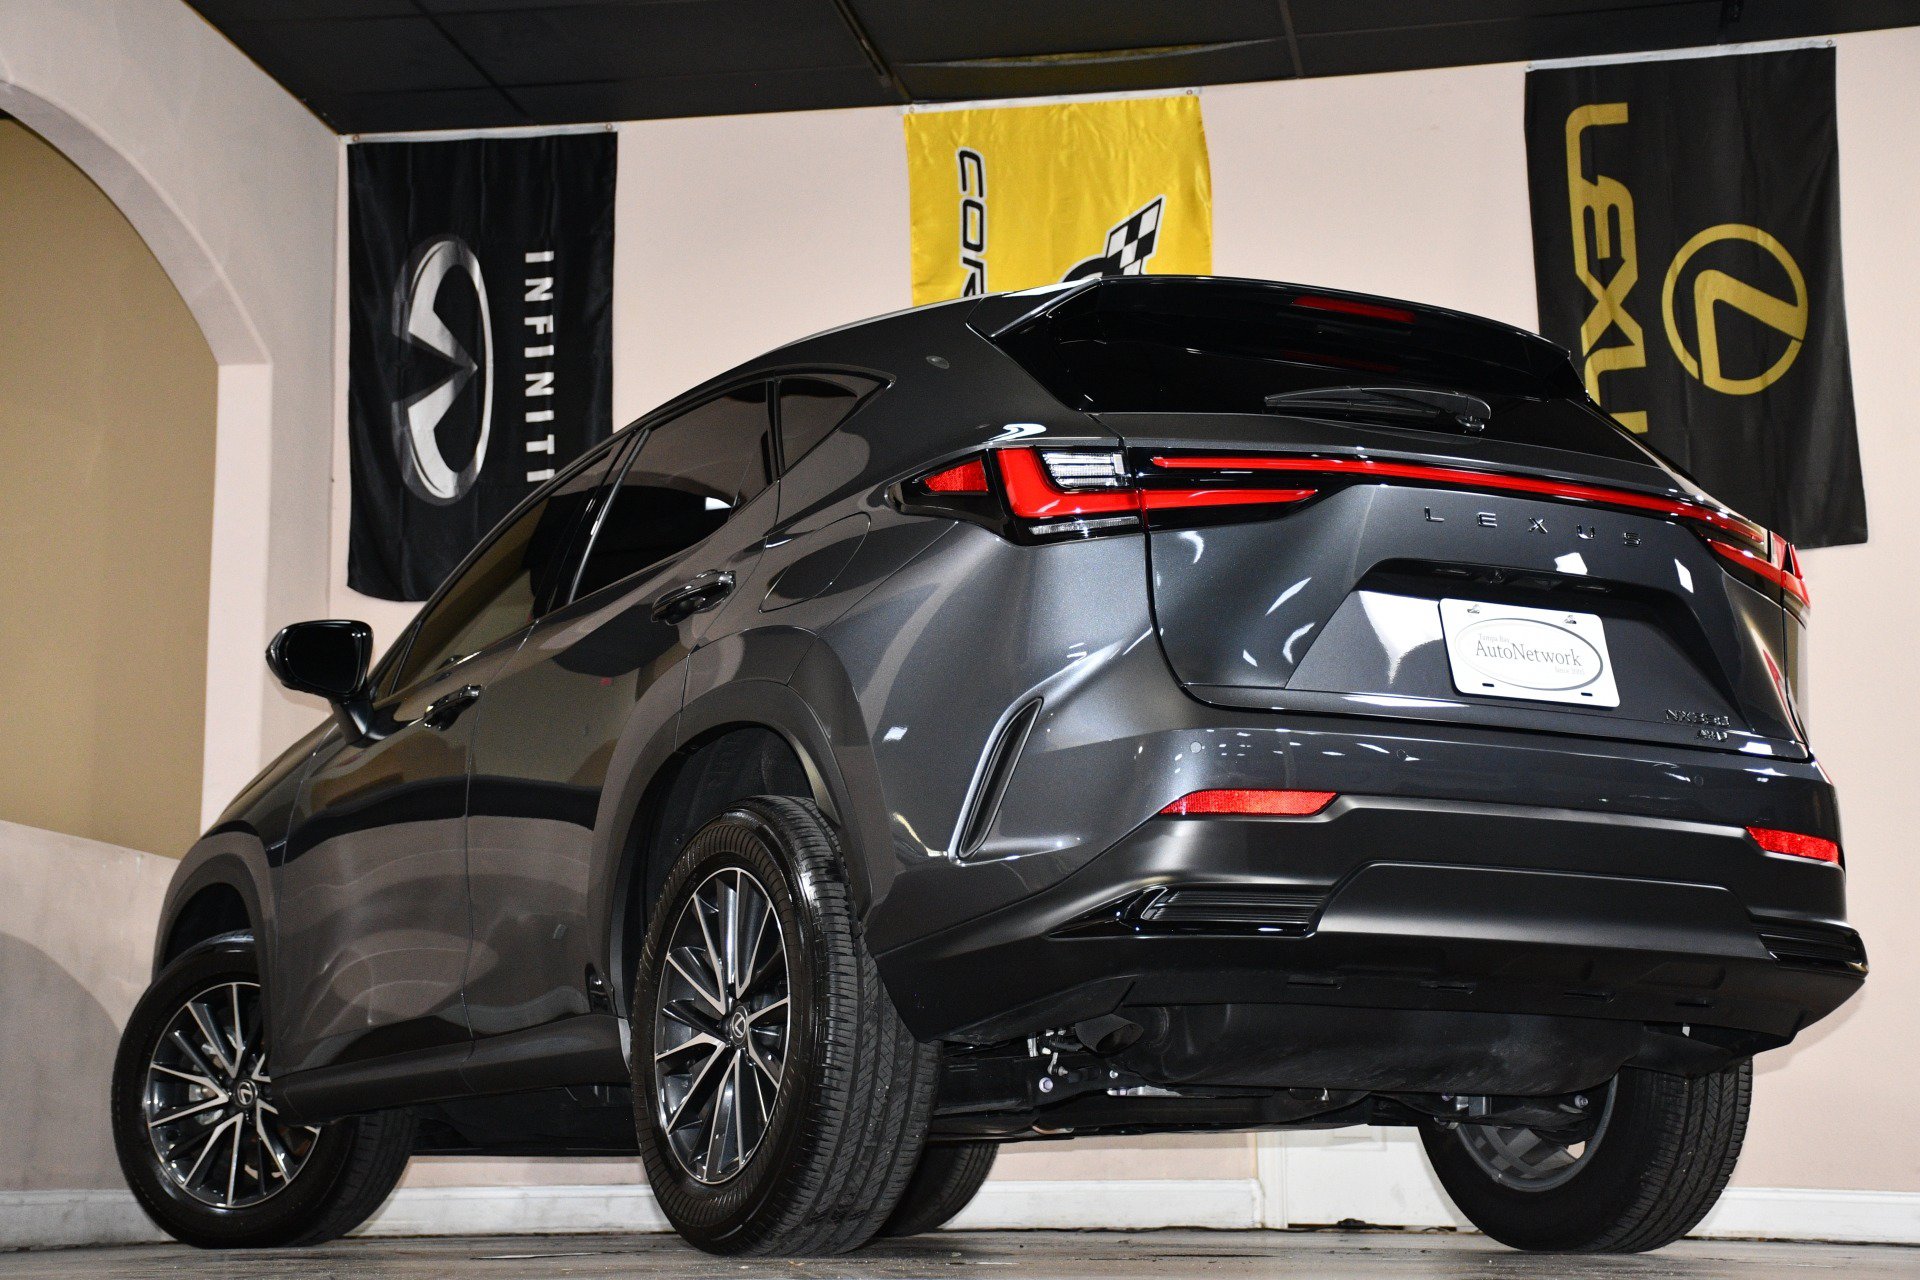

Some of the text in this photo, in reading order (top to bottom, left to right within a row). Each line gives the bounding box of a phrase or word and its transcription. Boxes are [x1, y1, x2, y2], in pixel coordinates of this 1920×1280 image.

[524, 250, 555, 483] INFINITI
[1423, 506, 1642, 547] LEXUS
[1475, 640, 1583, 667] AutoNetwork
